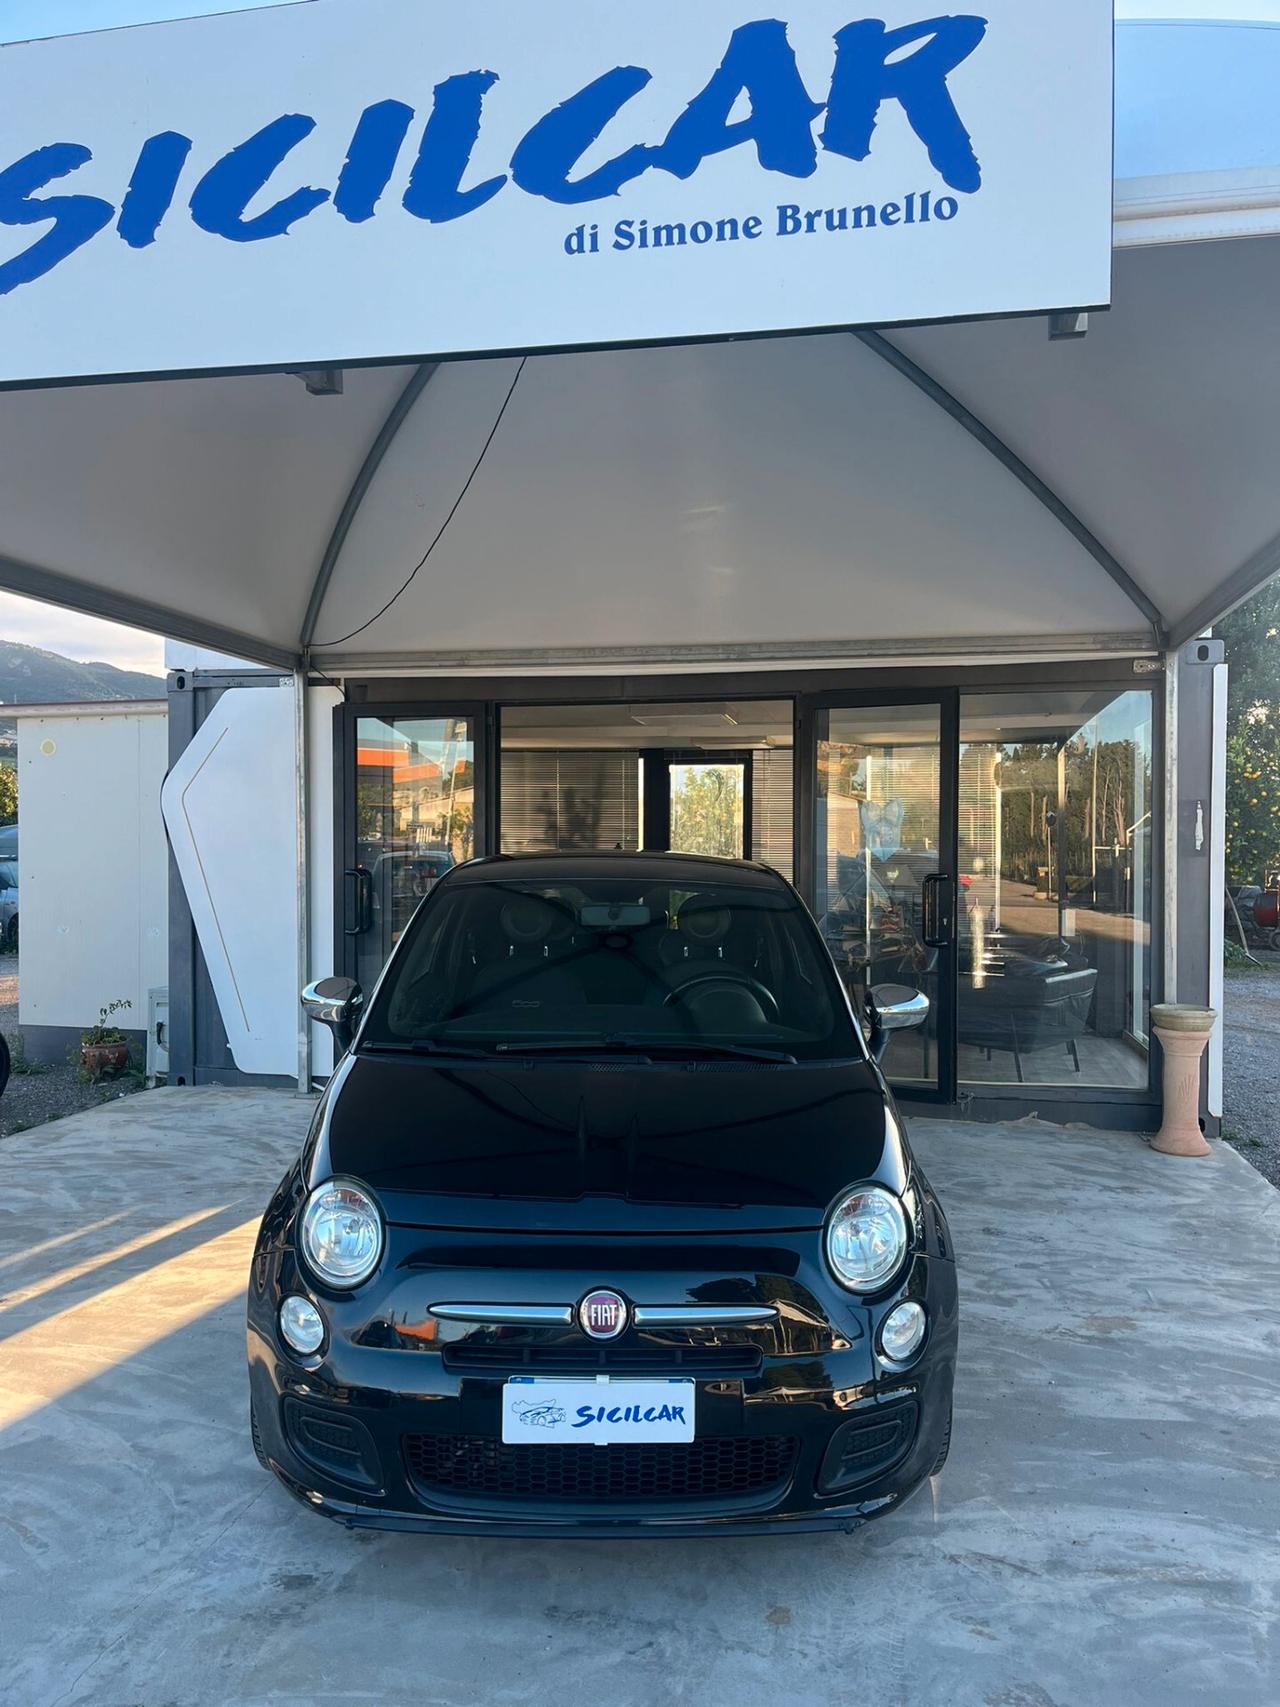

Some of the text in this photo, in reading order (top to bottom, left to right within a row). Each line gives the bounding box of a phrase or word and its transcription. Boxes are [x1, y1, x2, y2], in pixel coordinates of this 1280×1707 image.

[0, 15, 989, 295] SICILCAR
[563, 190, 959, 256] di Simone Brunello
[590, 1303, 618, 1327] FIAT
[571, 1404, 687, 1428] SICILCAR
